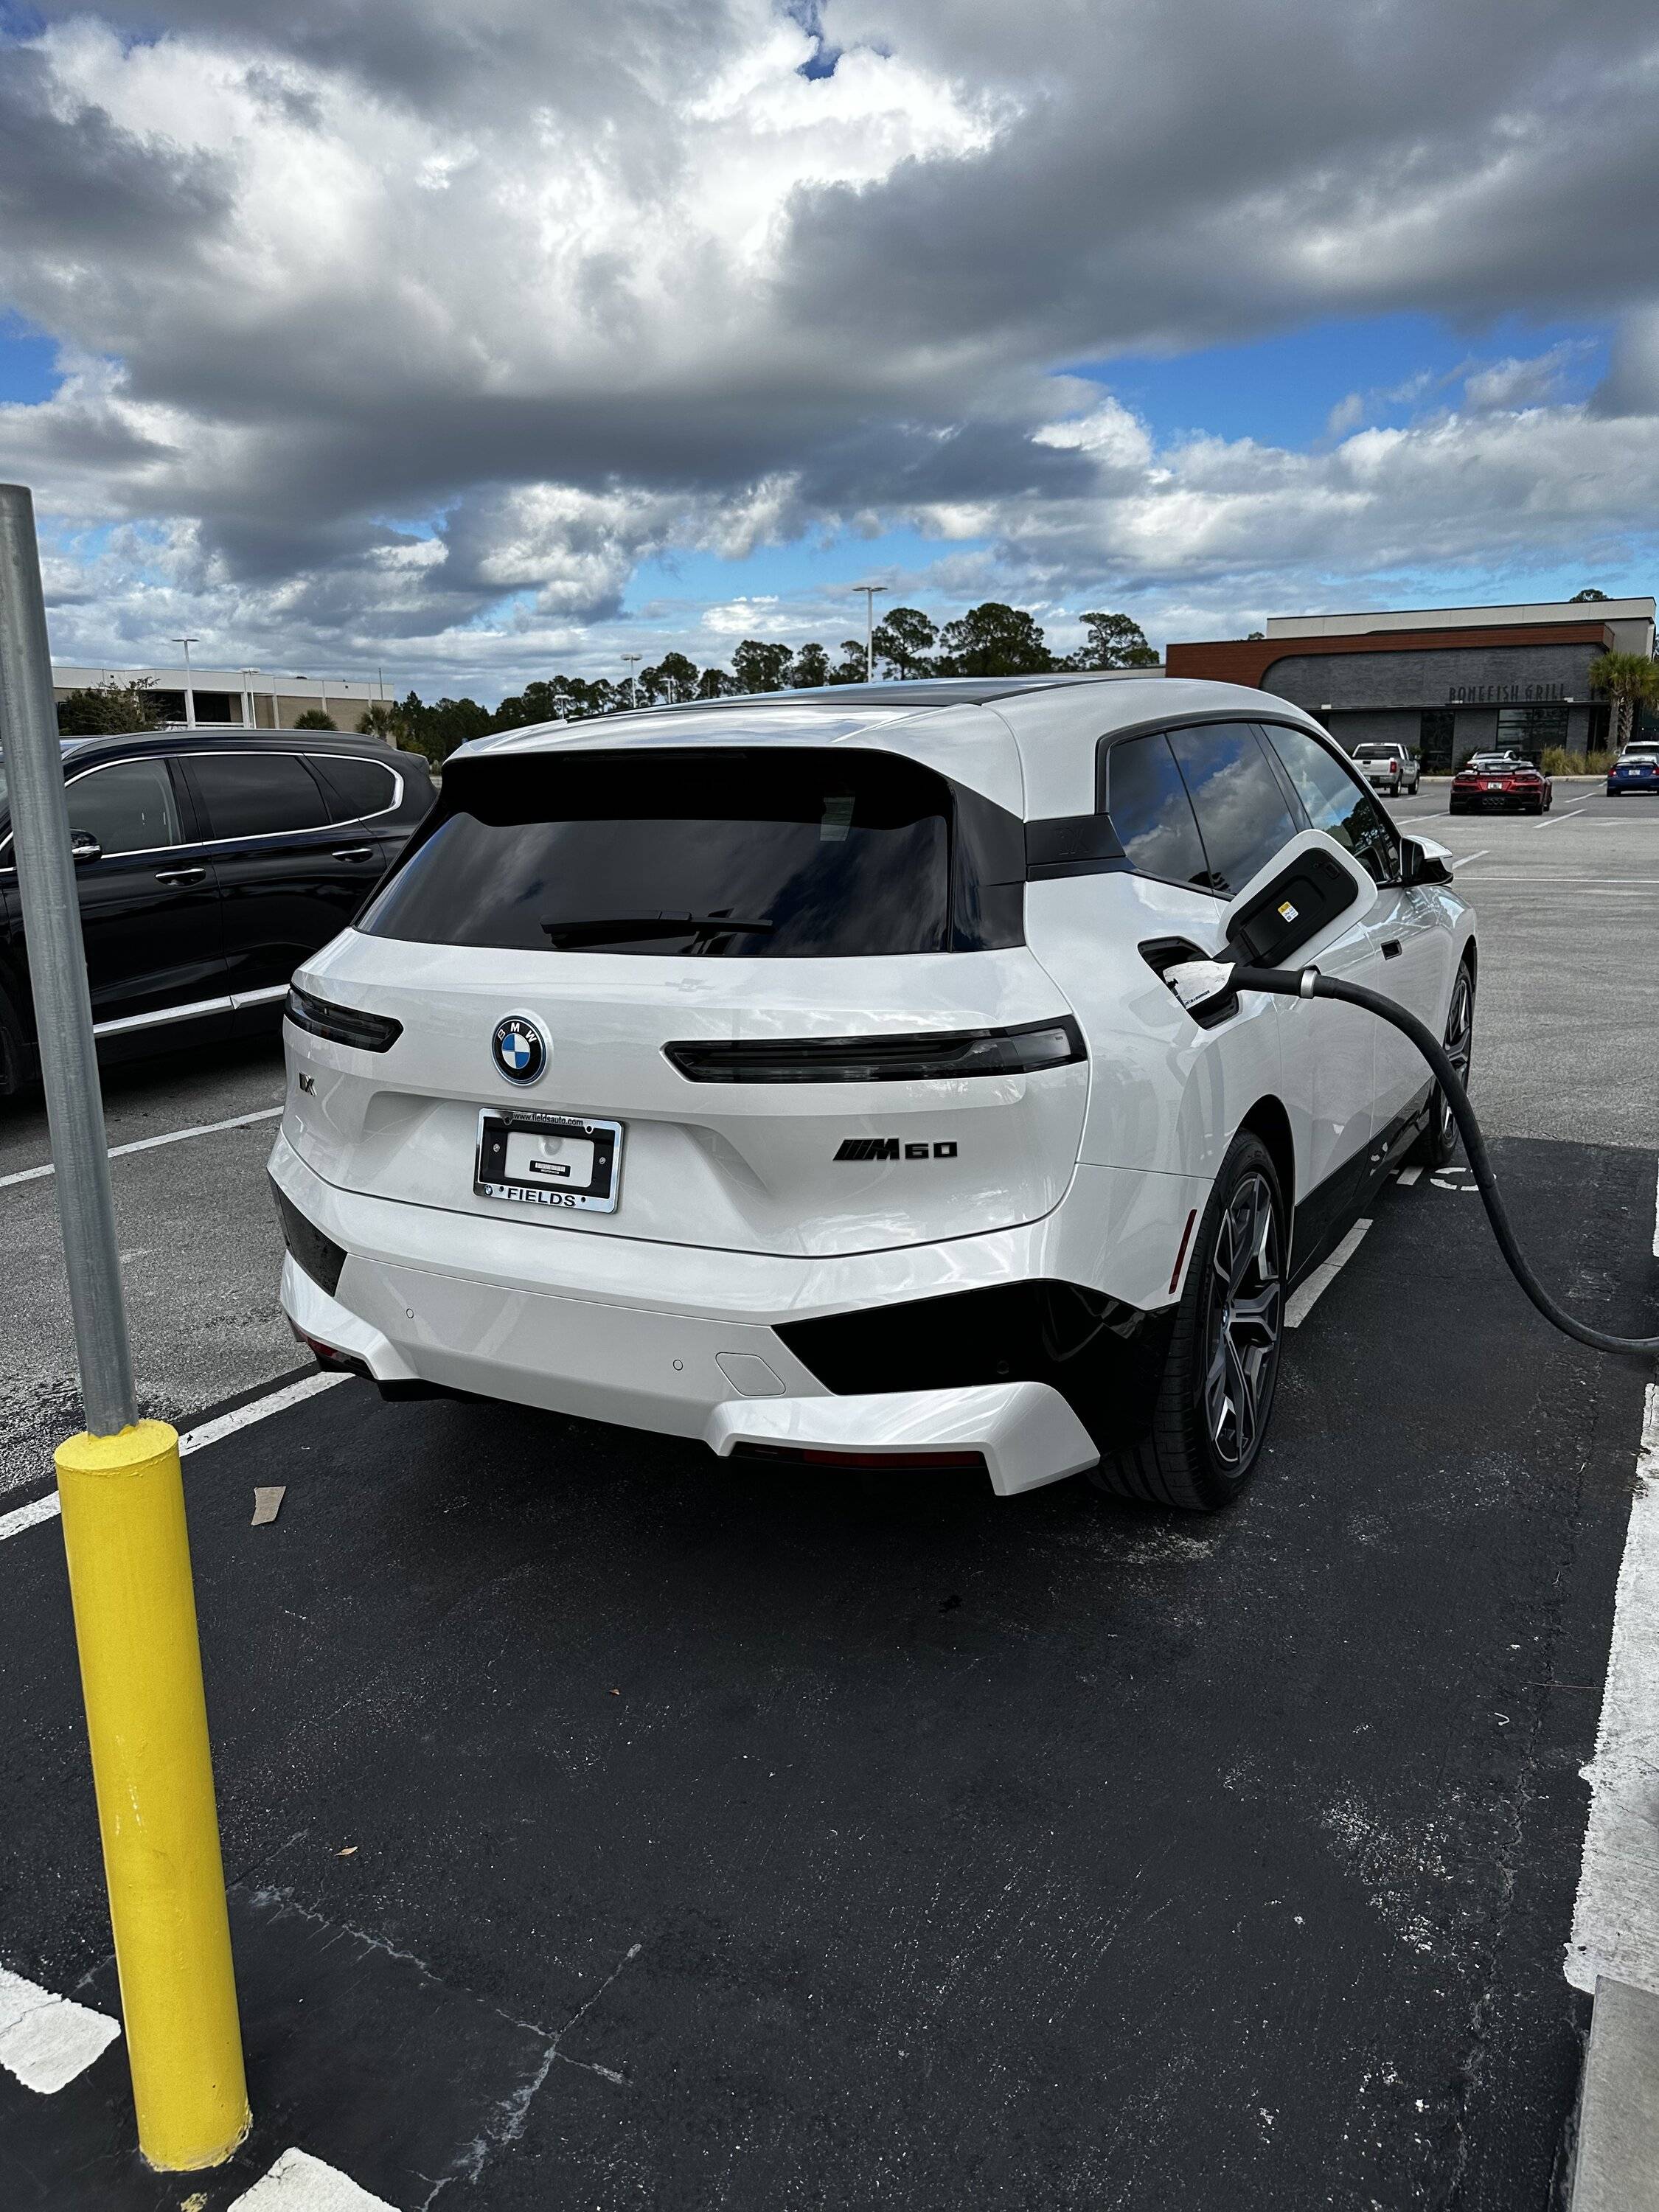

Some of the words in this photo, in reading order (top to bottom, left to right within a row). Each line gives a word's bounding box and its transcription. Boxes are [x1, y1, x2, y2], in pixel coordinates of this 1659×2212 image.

[1449, 685, 1519, 701] BONEFISH
[1525, 684, 1564, 700] GRILL
[498, 1022, 537, 1043] BMW
[513, 1112, 583, 1127] www.fieldsauto.com
[507, 1187, 576, 1207] FIELDS
